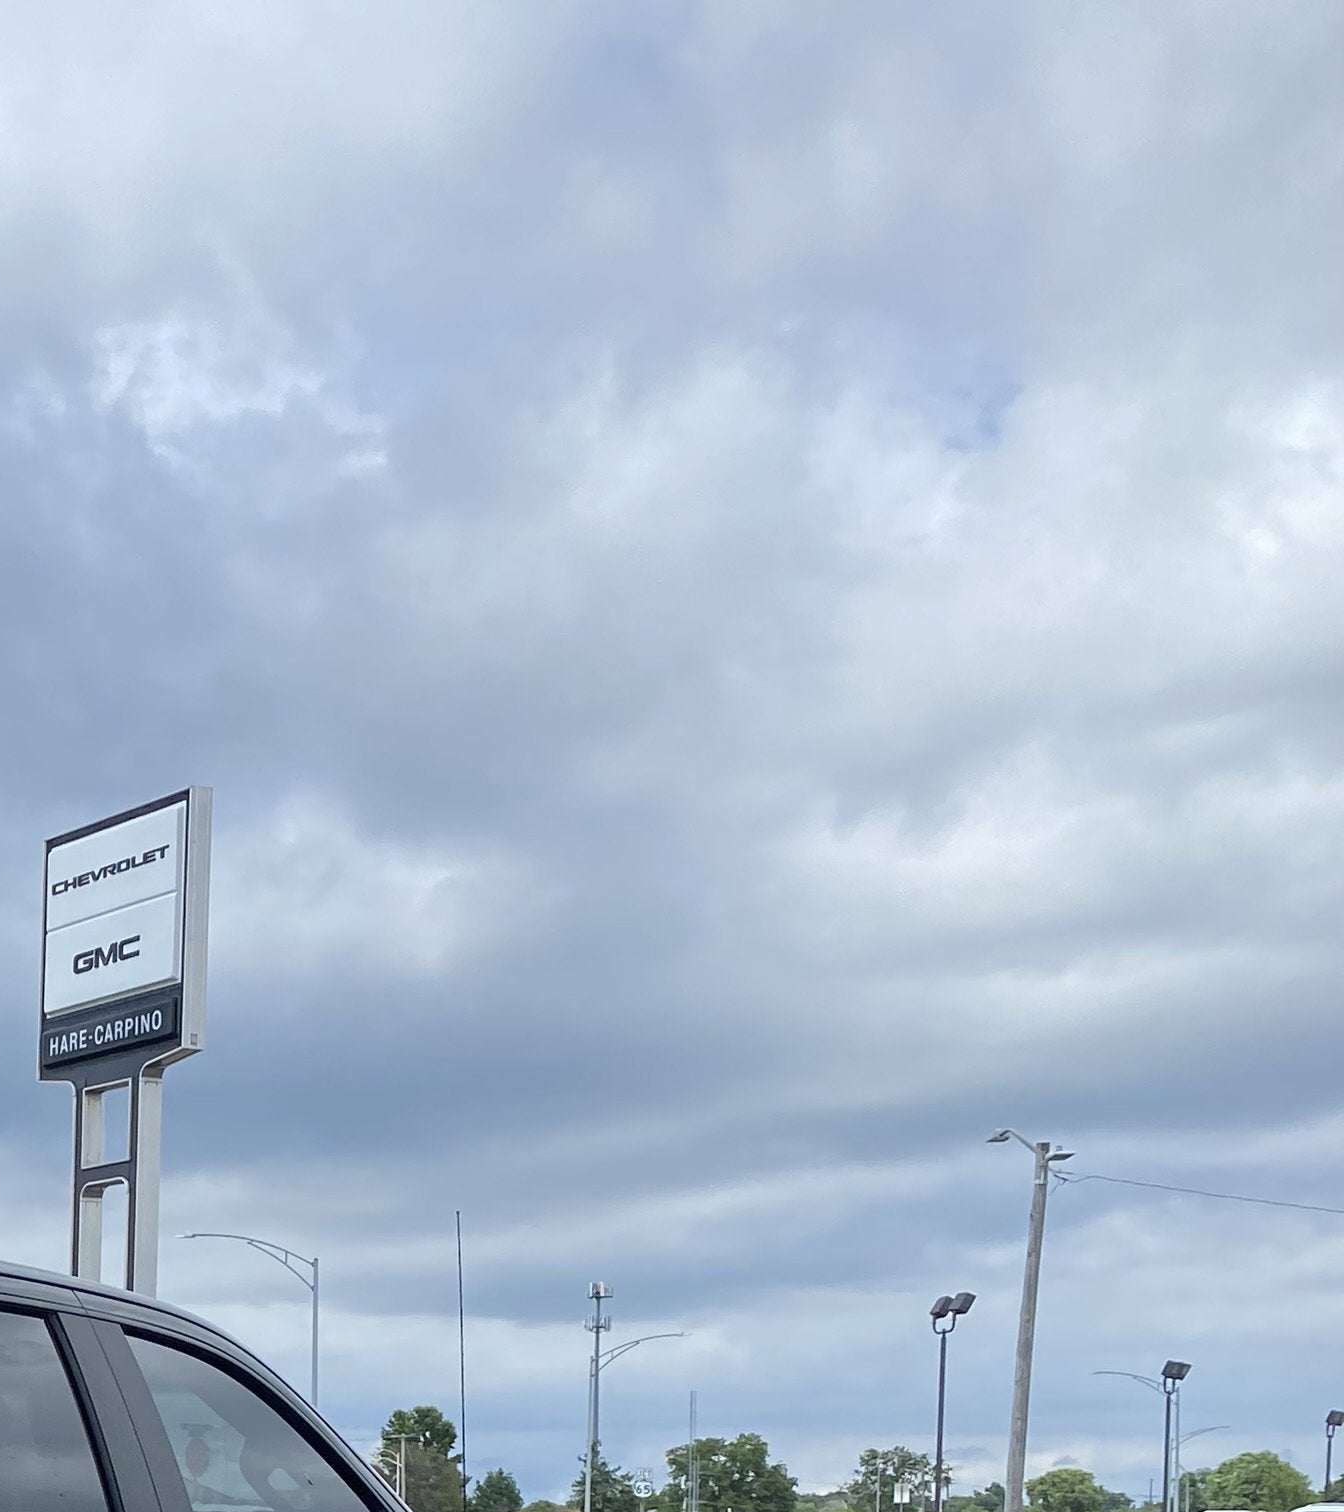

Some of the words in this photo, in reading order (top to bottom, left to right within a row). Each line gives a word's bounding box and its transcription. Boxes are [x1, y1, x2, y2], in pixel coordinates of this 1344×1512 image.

[51, 844, 170, 896] CHEVROLET
[72, 935, 141, 975] GMC
[49, 1010, 163, 1057] HARE-CARPINO
